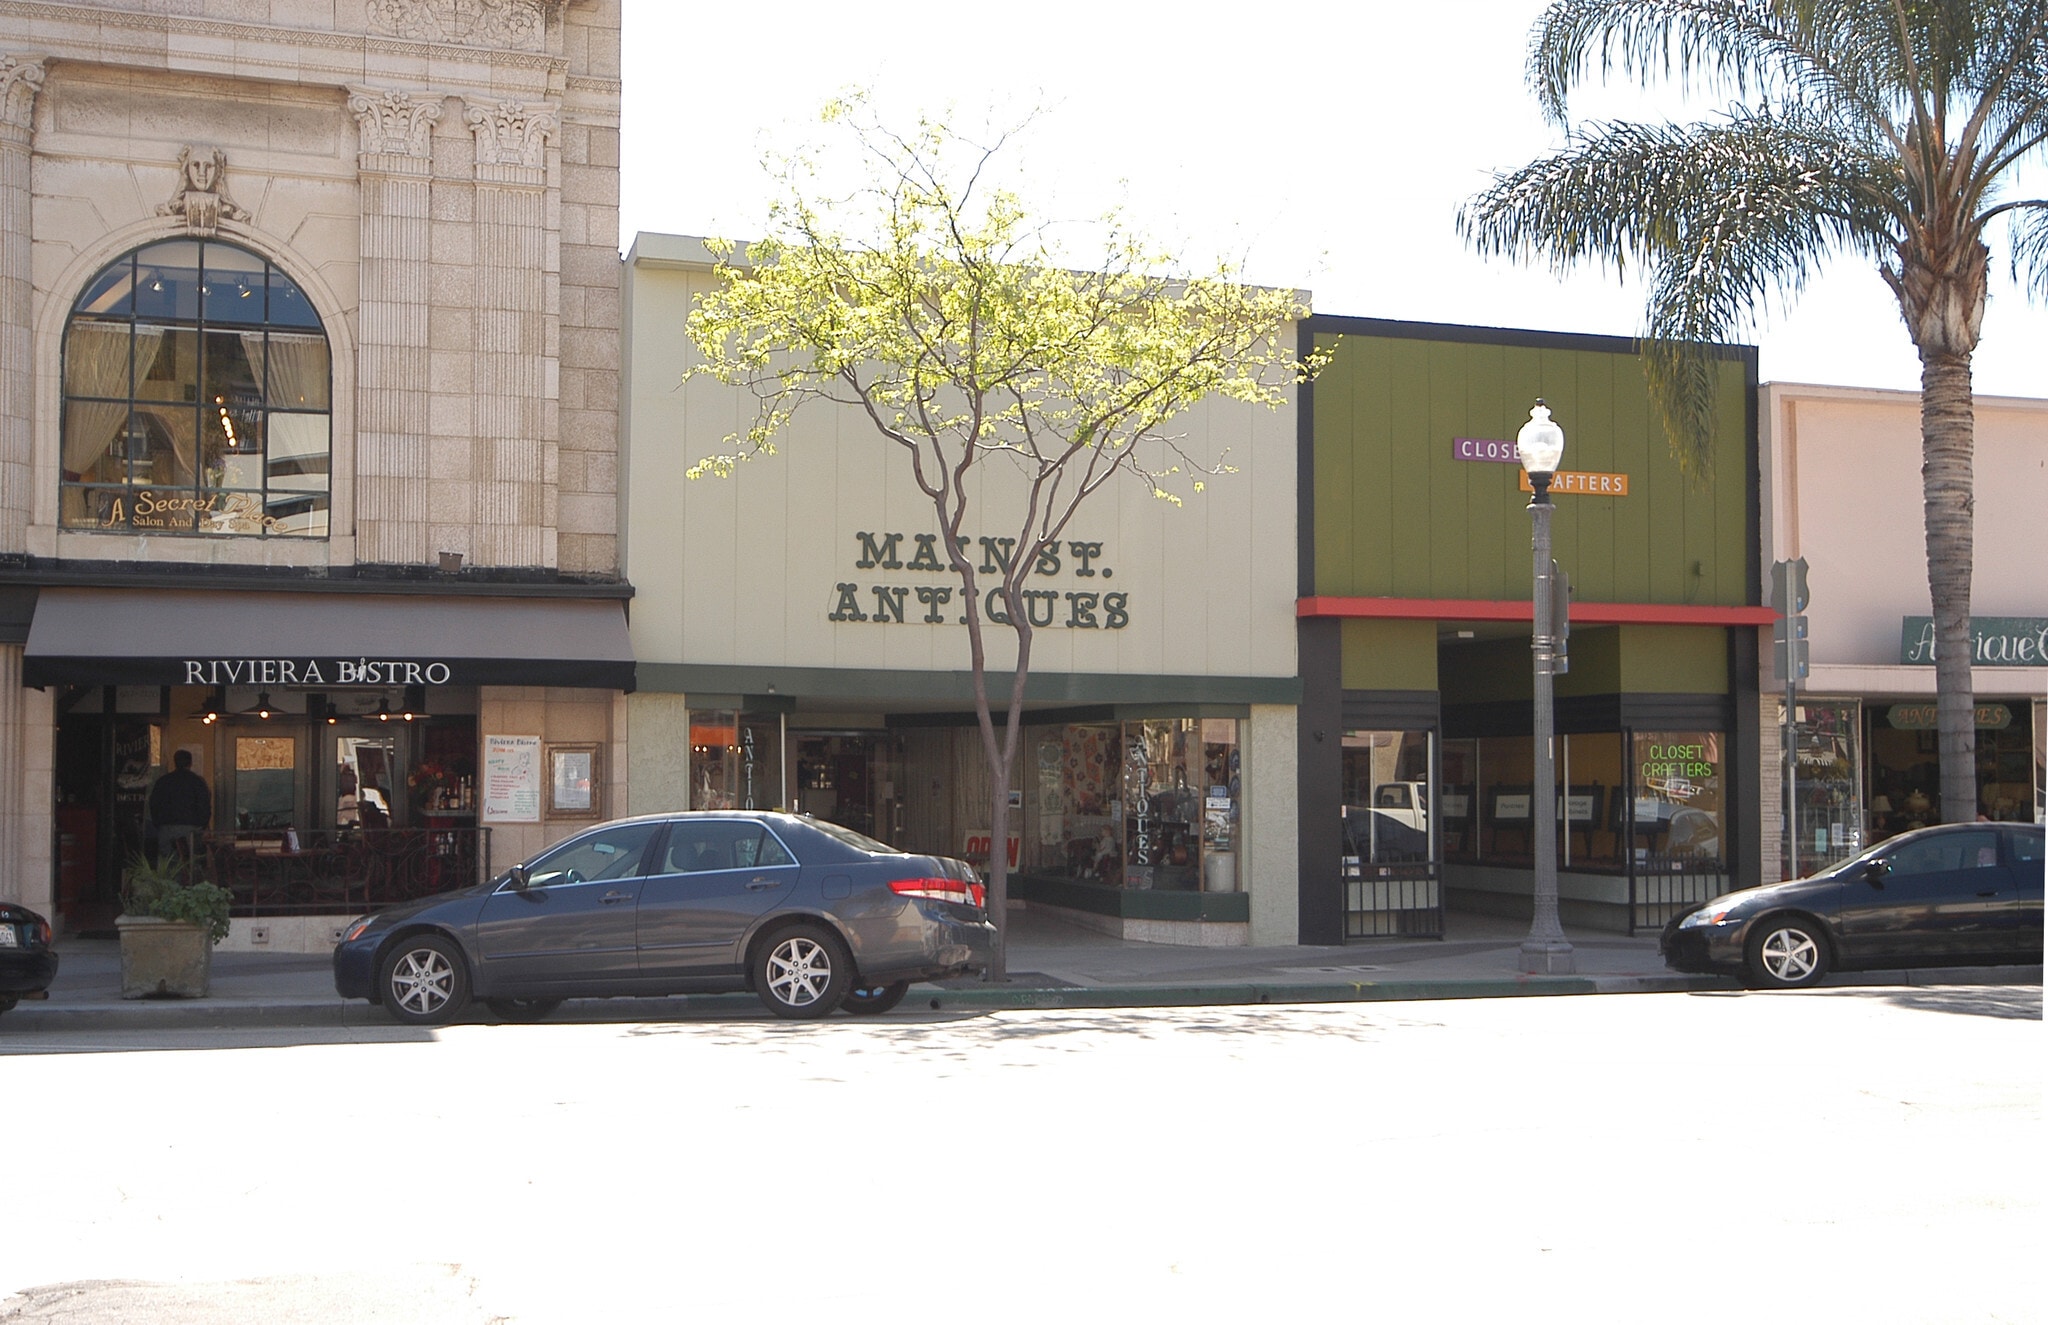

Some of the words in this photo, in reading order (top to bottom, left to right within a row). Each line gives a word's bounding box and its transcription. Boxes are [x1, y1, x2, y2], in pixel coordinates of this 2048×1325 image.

[1461, 440, 1521, 460] CLOSE
[1528, 472, 1623, 493] AFTERS
[101, 497, 126, 527] A
[134, 490, 220, 516] Secret
[224, 493, 289, 533] Place
[132, 515, 164, 527] Salon
[168, 516, 193, 528] And
[198, 517, 224, 531] Day
[1034, 539, 1113, 579] ST.
[1908, 622, 2036, 662] Aique
[183, 659, 326, 685] RIVIERA
[336, 657, 451, 685] BISTRO
[1898, 704, 2003, 727] ANTES
[1650, 744, 1704, 760] CLOSET
[1642, 762, 1712, 777] CRAFTERS
[1132, 735, 1149, 865] ANTIQUES
[966, 835, 1020, 867] OPN
